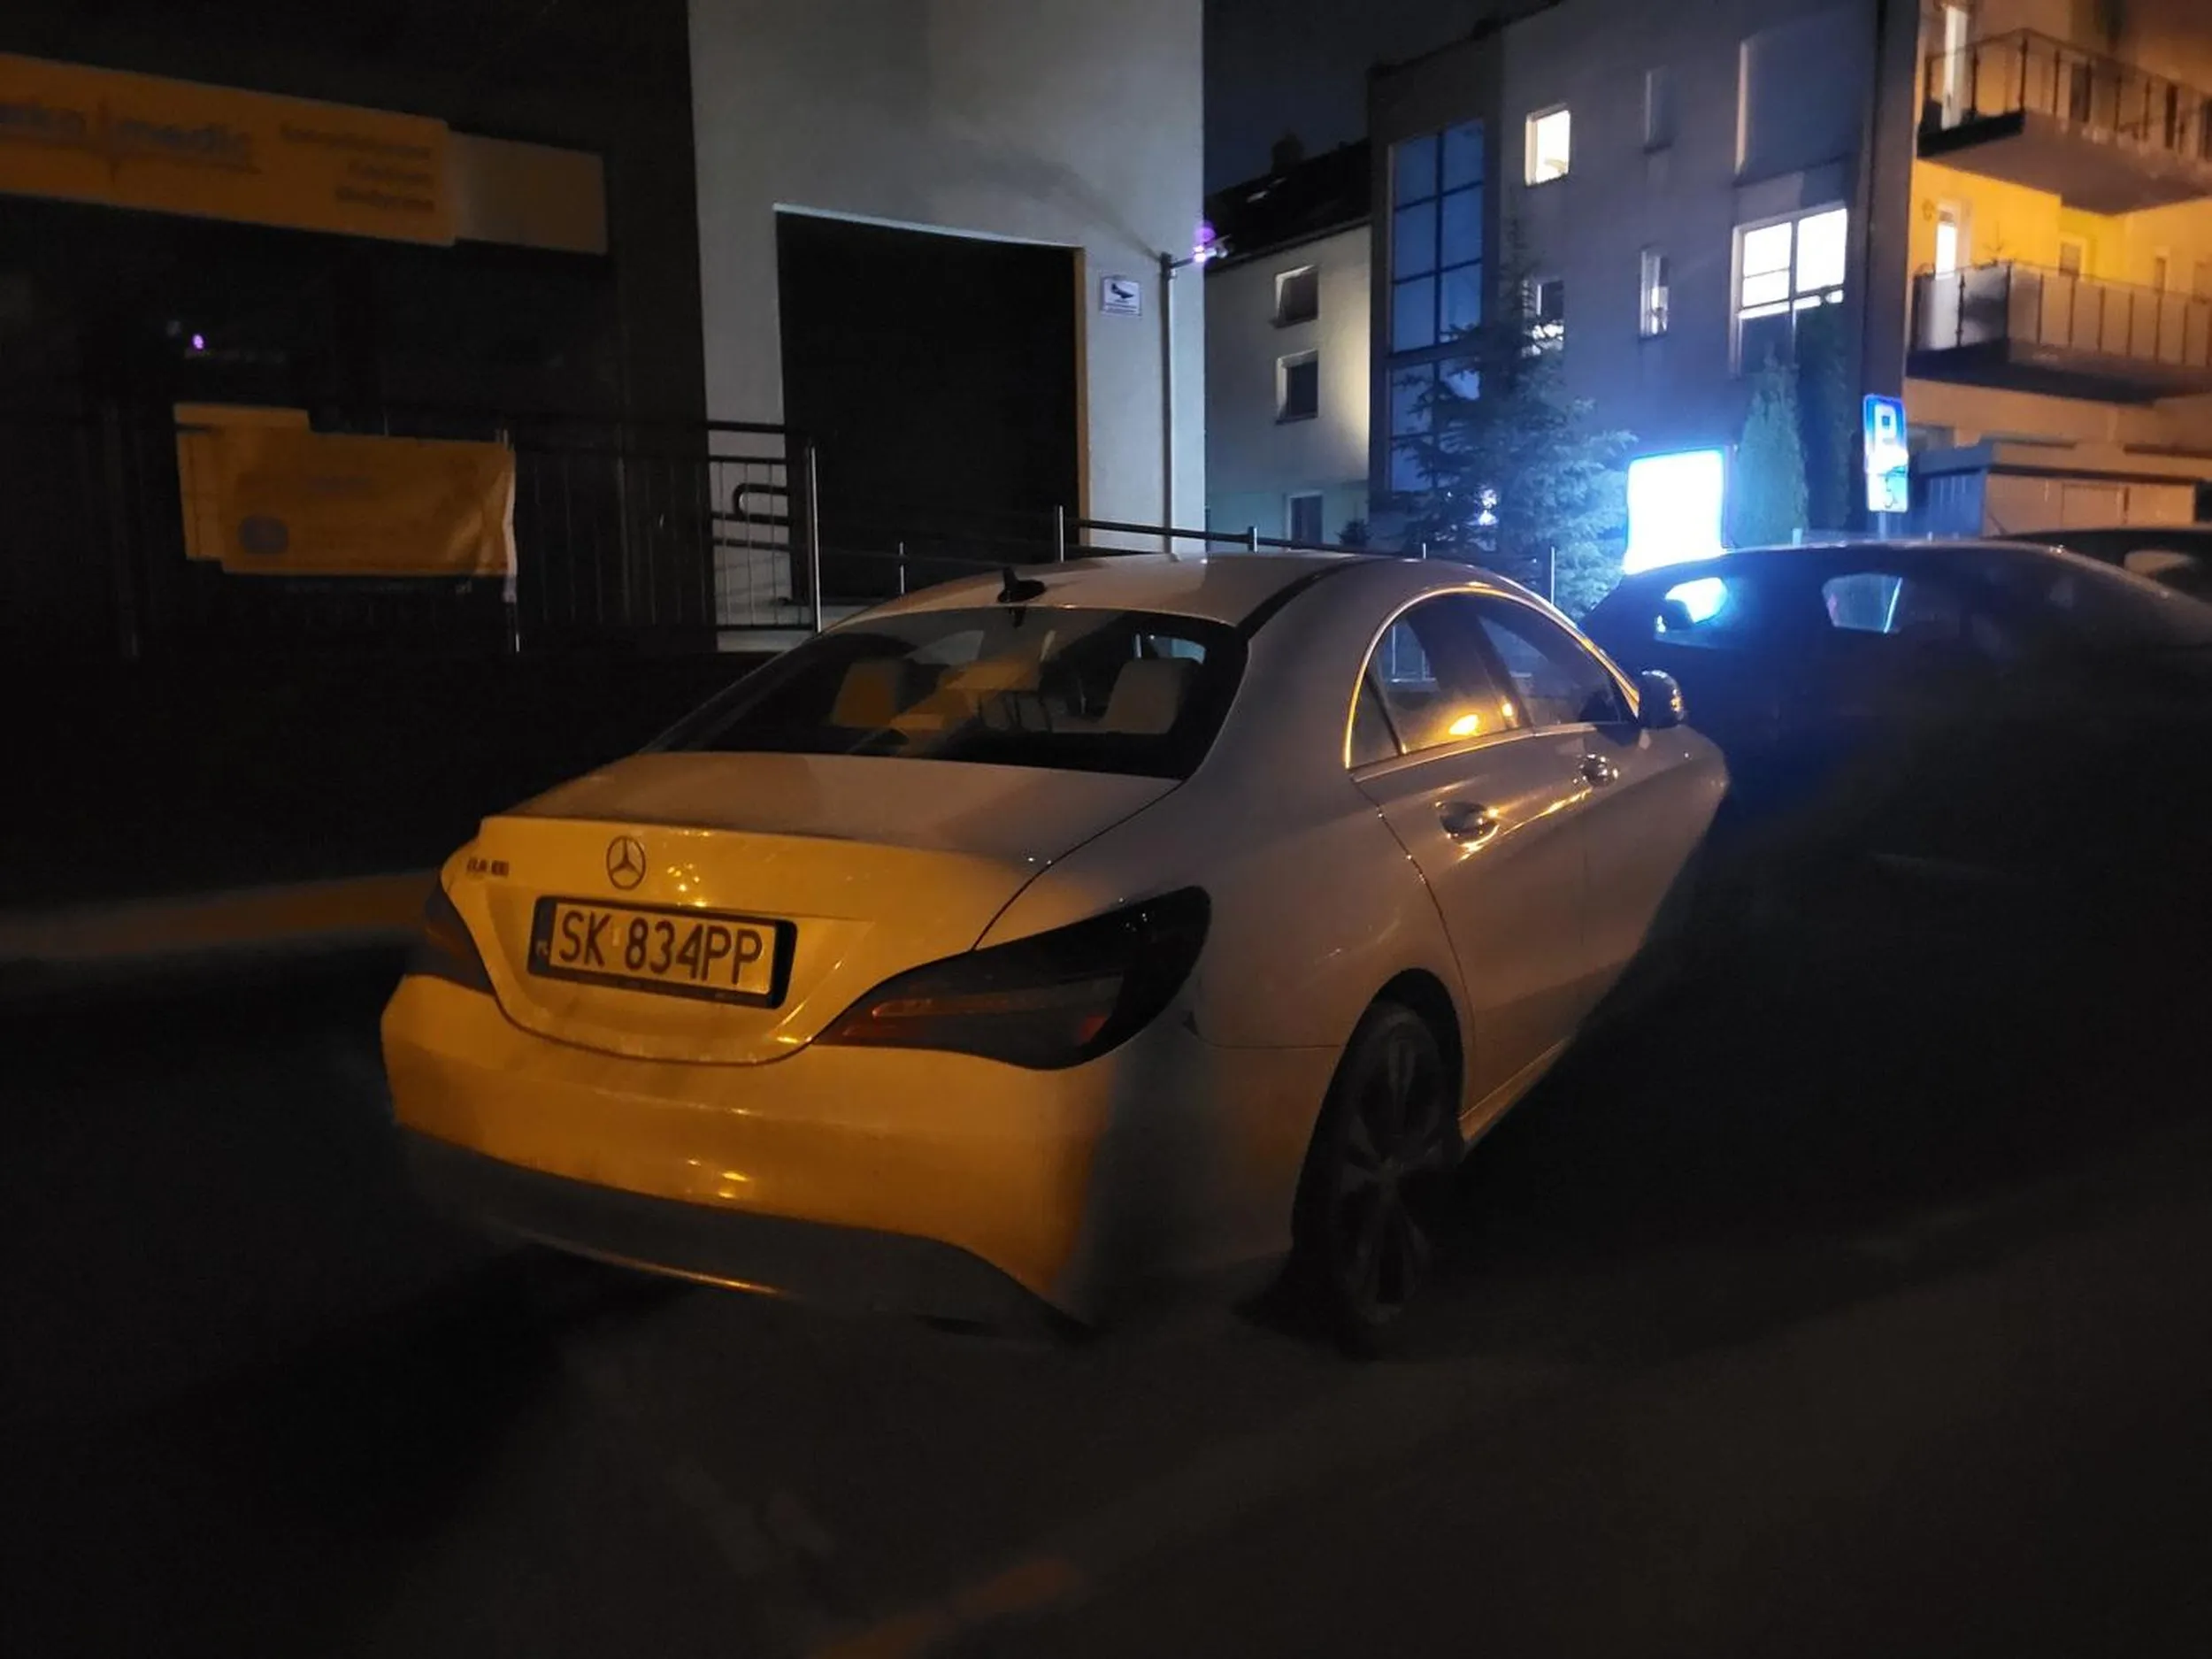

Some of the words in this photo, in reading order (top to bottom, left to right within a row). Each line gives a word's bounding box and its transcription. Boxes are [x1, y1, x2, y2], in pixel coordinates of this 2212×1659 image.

[1874, 403, 1897, 457] P
[559, 911, 611, 967] SK
[626, 918, 763, 985] 834PP
